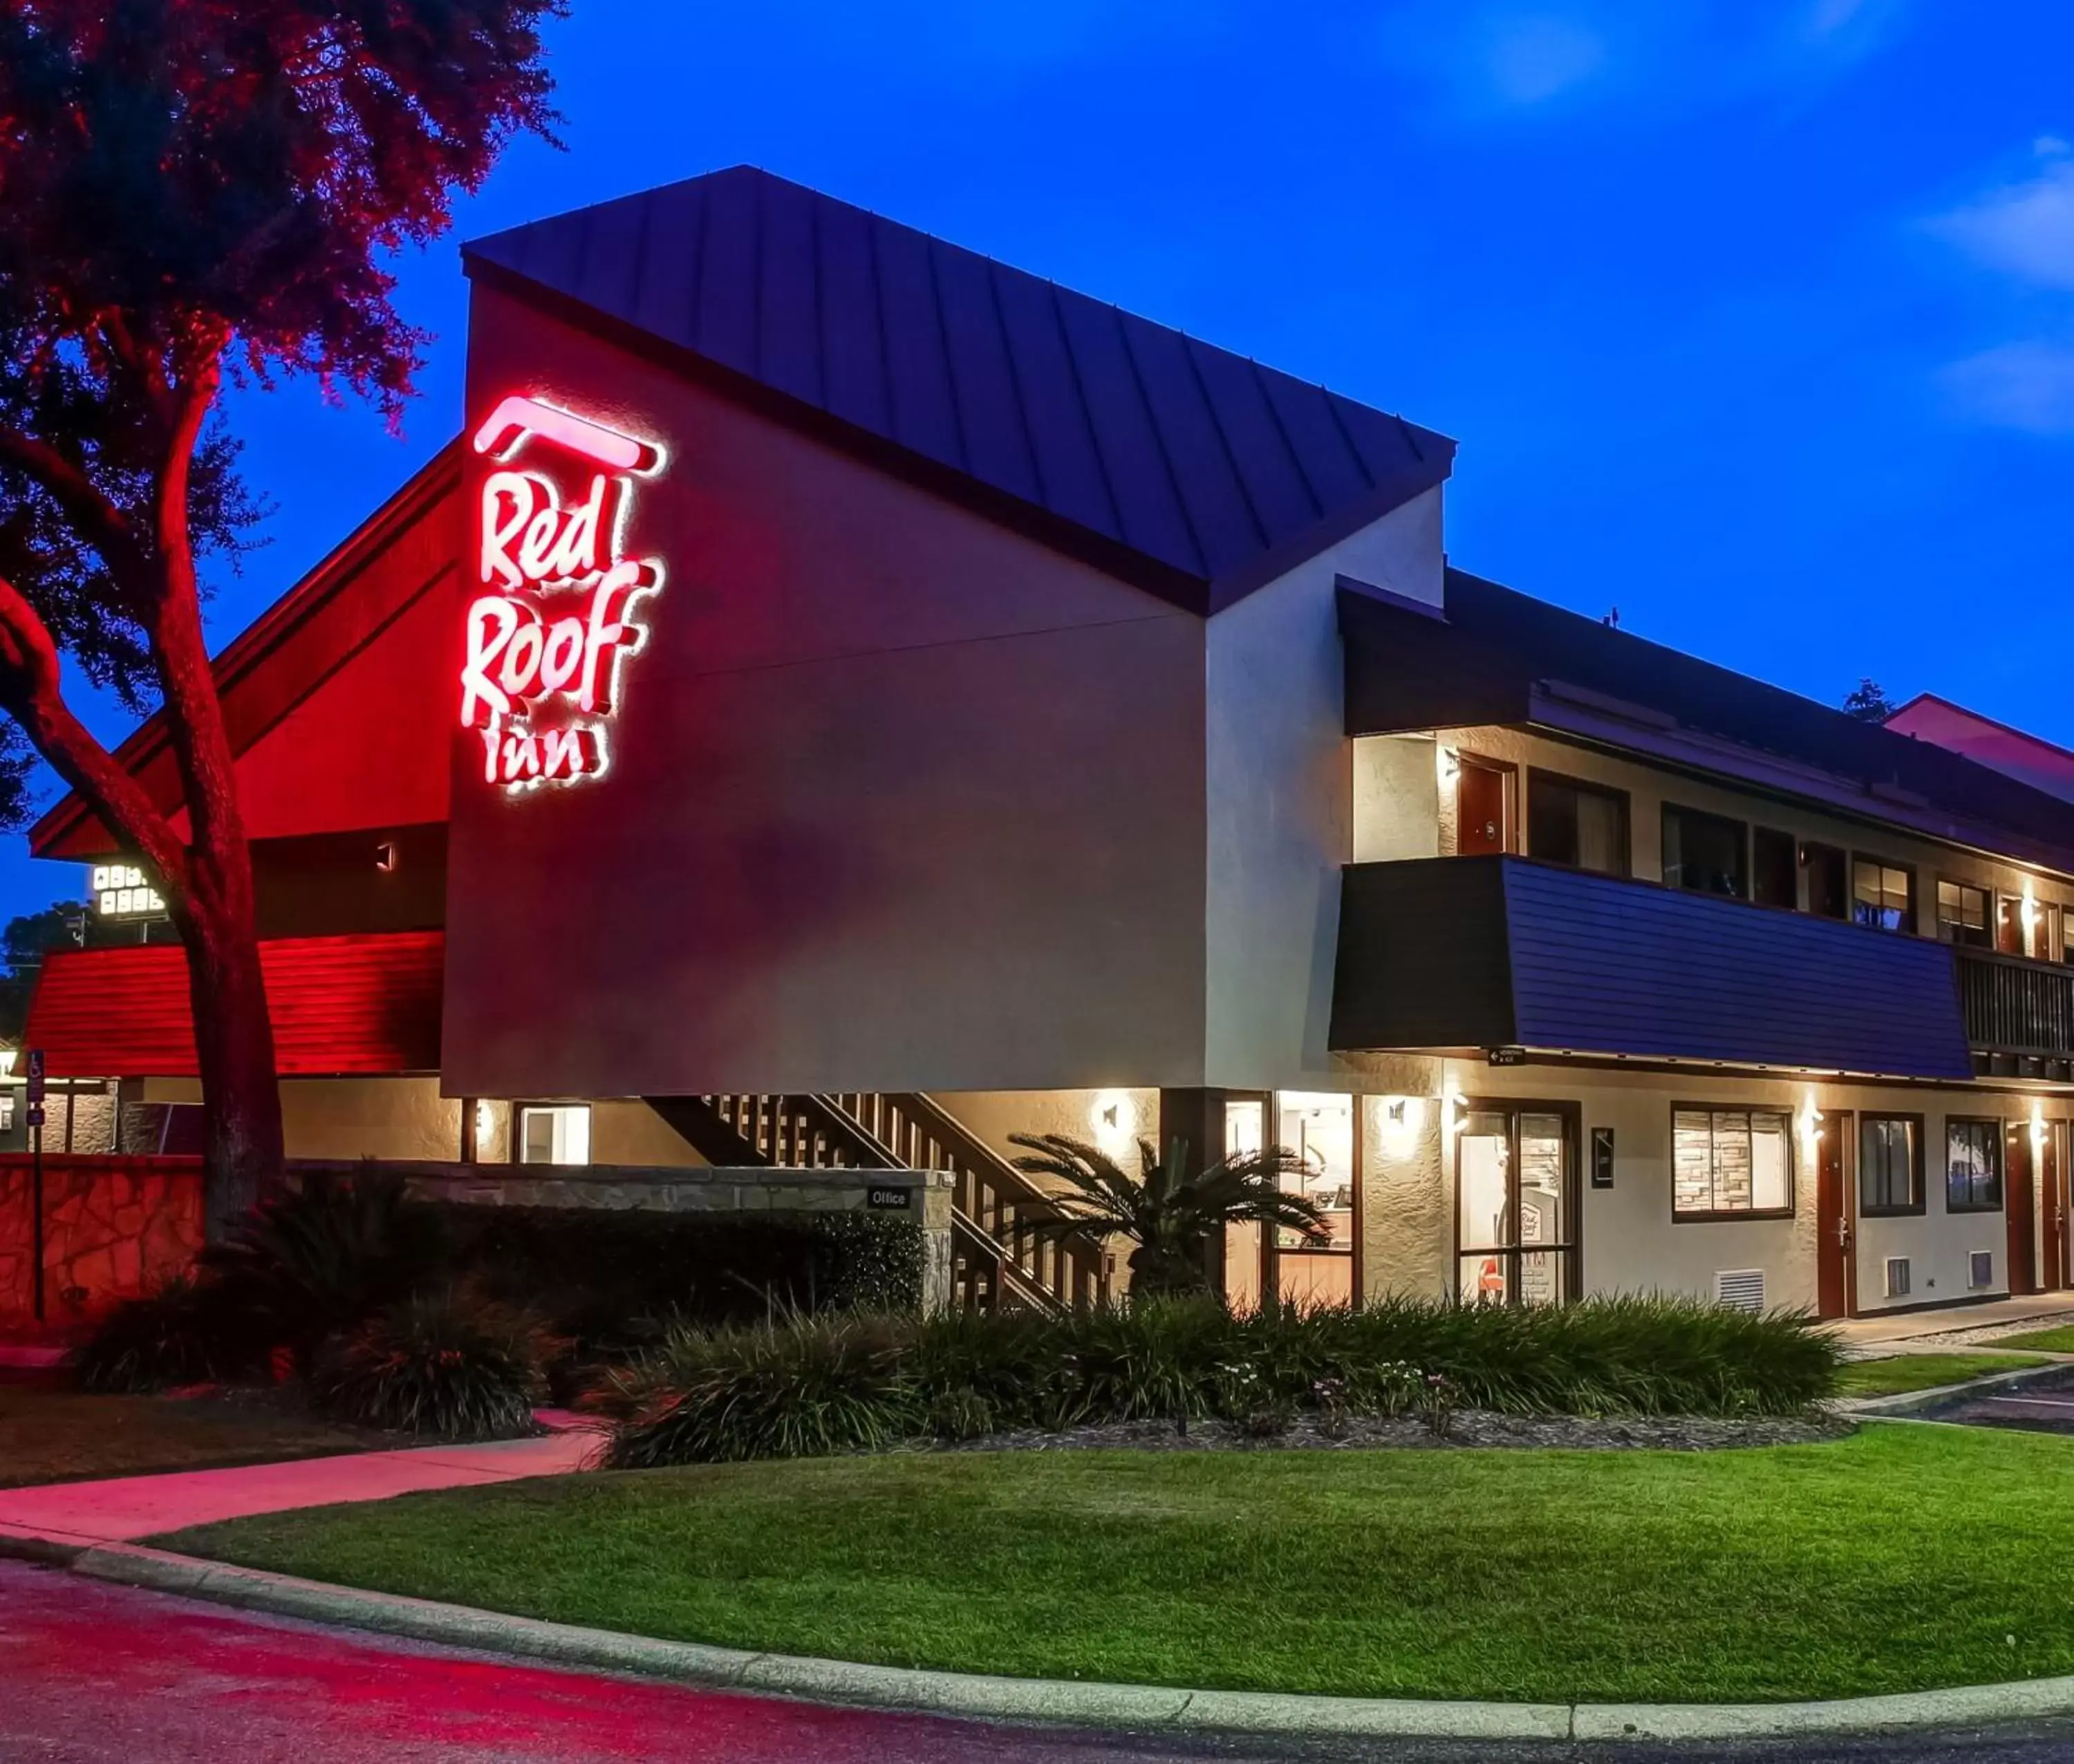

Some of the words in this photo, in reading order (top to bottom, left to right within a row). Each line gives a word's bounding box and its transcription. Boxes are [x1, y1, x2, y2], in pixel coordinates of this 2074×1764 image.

[480, 471, 606, 589] Red
[460, 561, 640, 728] Roof
[872, 1191, 906, 1205] Office
